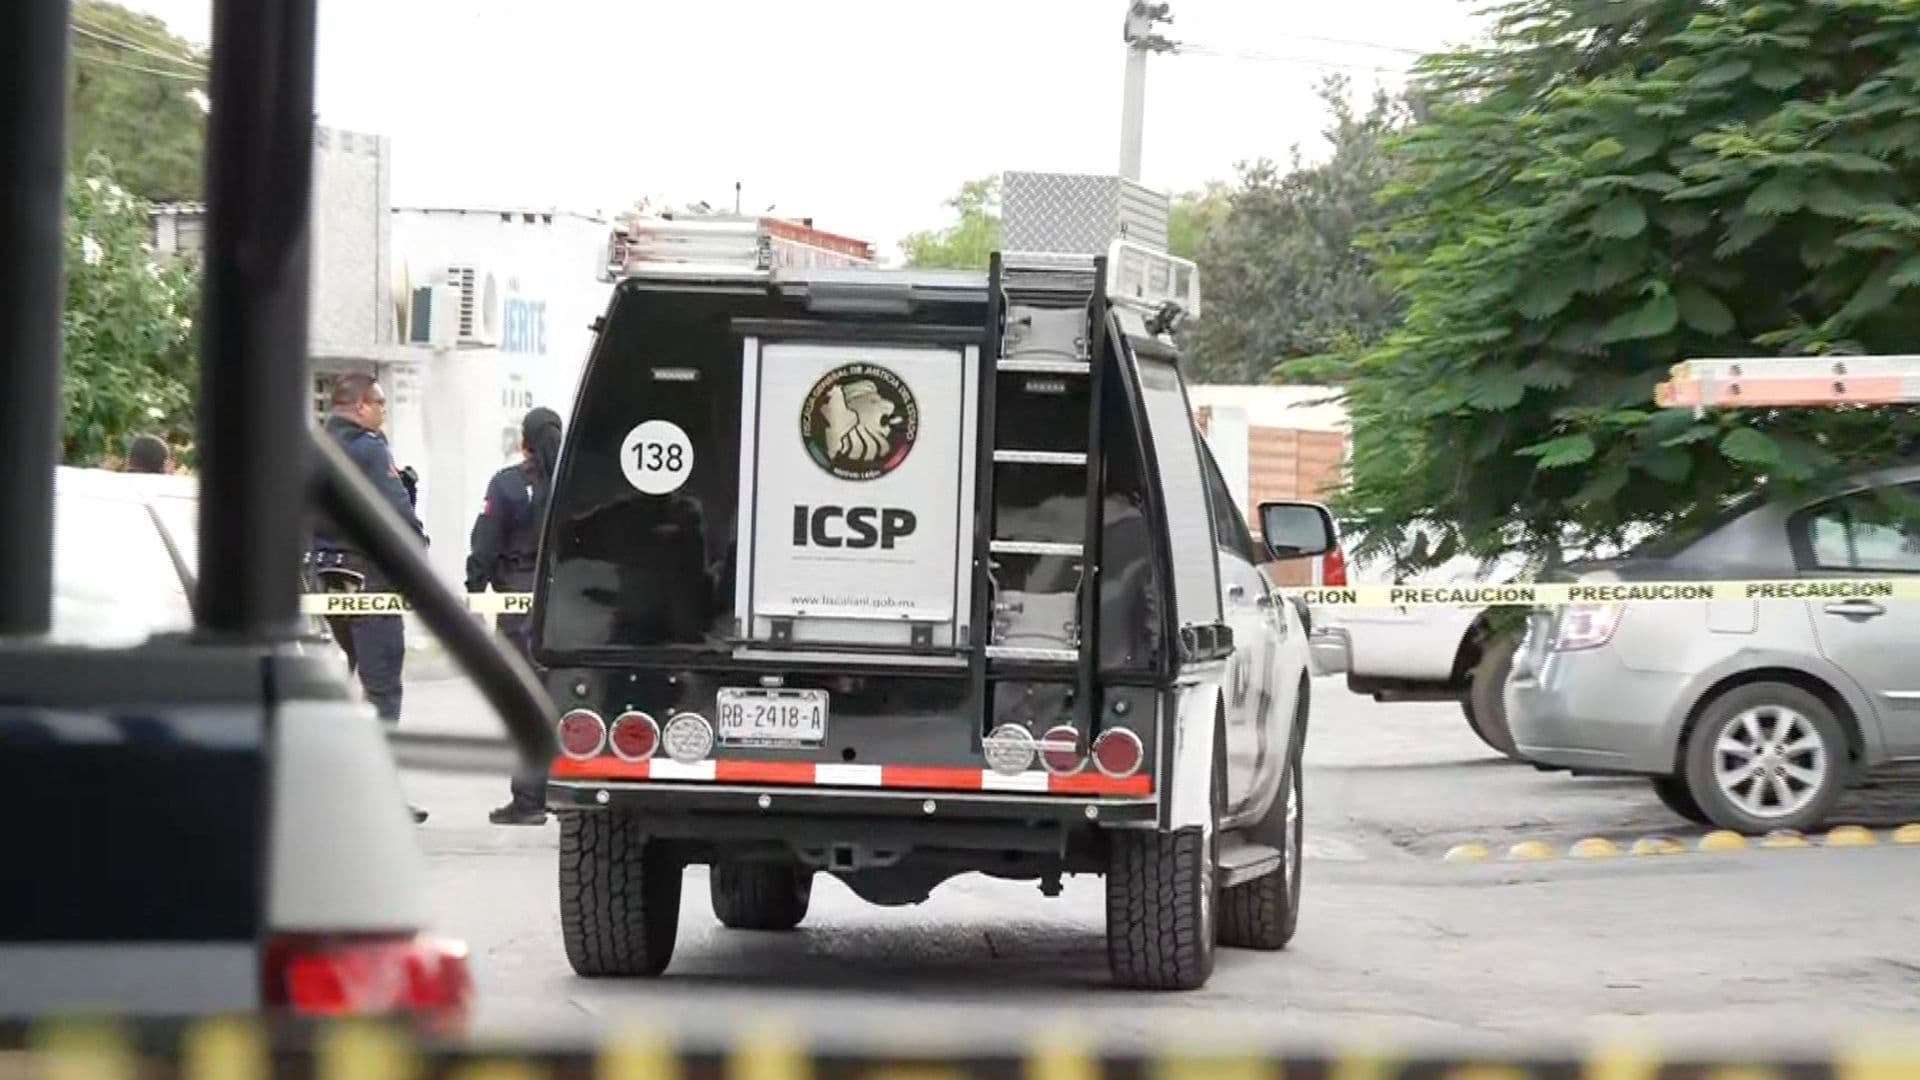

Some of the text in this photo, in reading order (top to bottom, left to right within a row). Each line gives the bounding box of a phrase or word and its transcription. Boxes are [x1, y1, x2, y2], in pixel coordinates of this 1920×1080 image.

[632, 442, 683, 471] 138
[793, 505, 917, 549] ICSP
[327, 596, 412, 611] PRECAU
[1303, 582, 1893, 604] CION PRECAUCION PRECAUCION PRECAUCION
[721, 704, 820, 729] RB-2418-A
